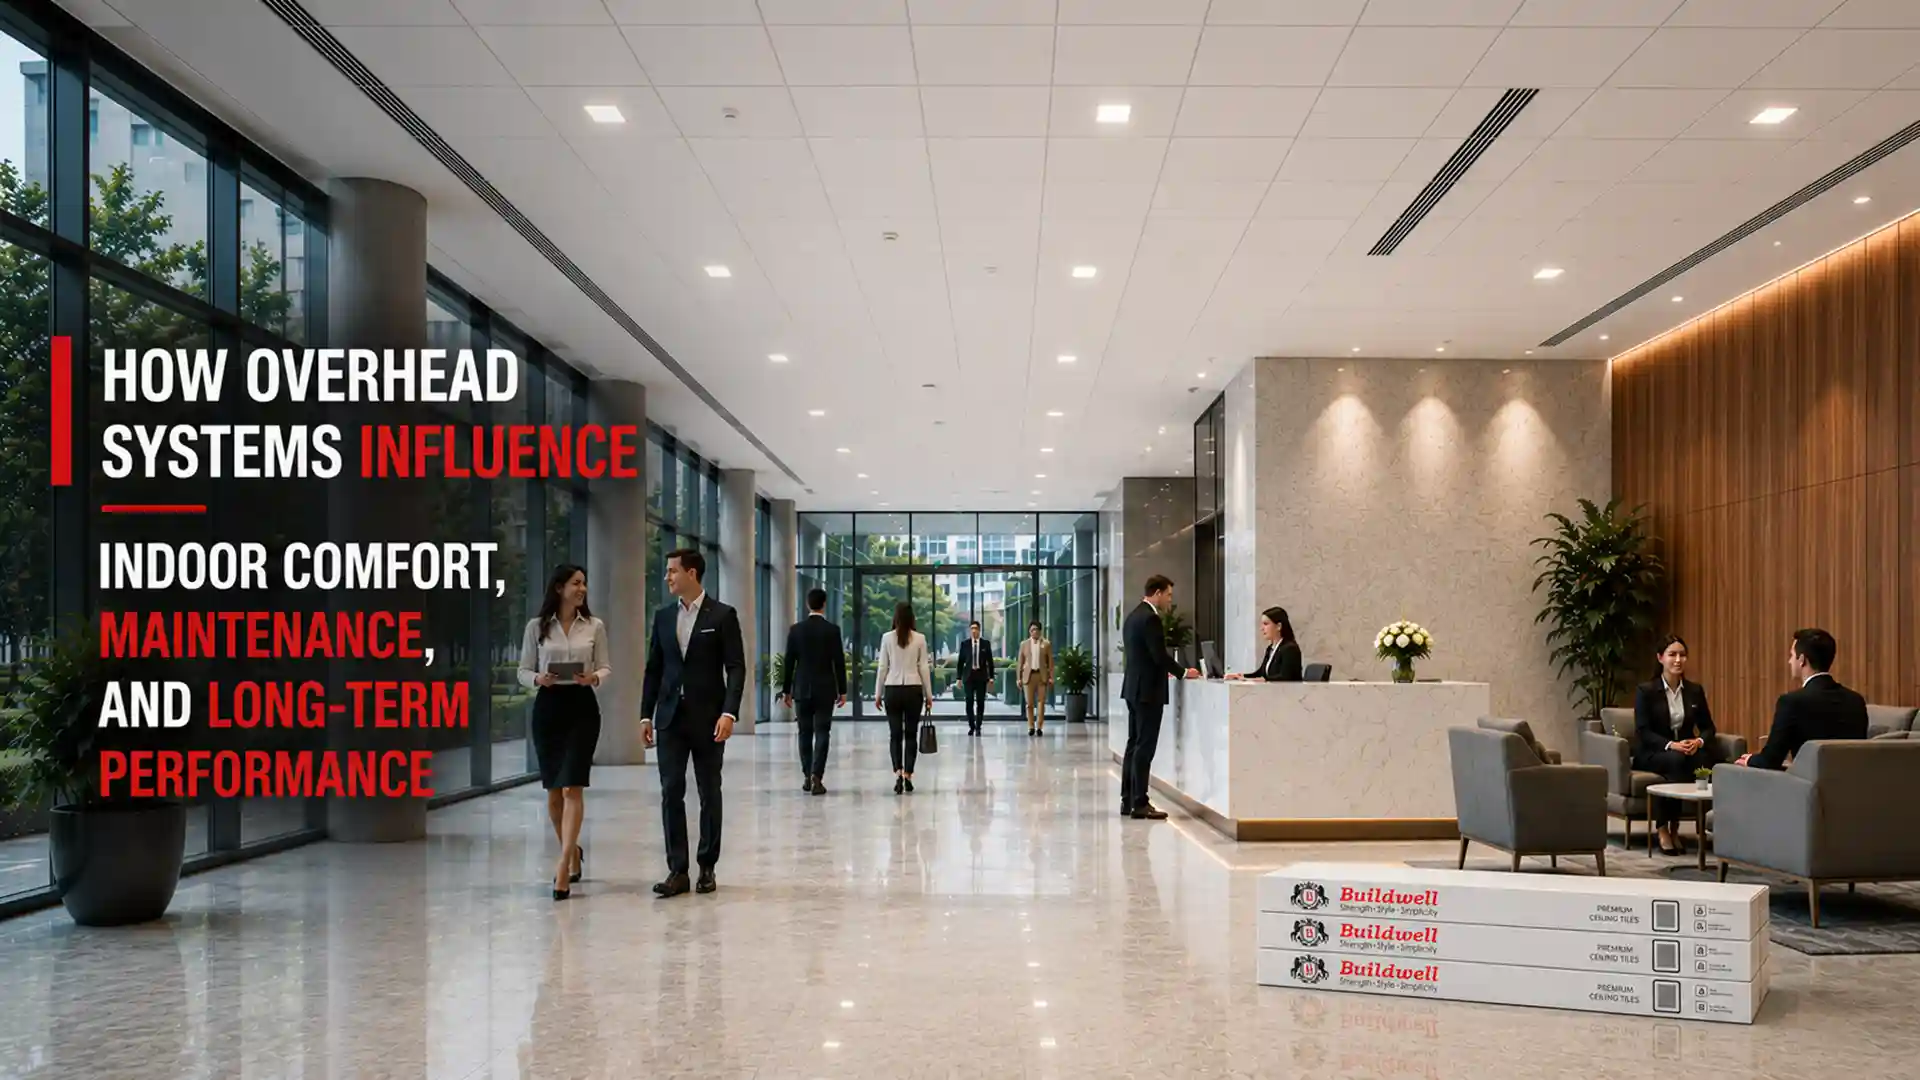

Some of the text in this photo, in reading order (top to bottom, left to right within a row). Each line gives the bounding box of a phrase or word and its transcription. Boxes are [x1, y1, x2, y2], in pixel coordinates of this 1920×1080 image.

[1339, 887, 1439, 906] Buildwell
[1597, 905, 1633, 914] PREMIUM
[1620, 915, 1640, 924] TILES
[1339, 923, 1438, 943] Buildwell
[1597, 944, 1634, 953] PREMIUM
[1620, 955, 1640, 964] TILES
[1339, 960, 1439, 982] Buildwell
[1597, 984, 1634, 993] PREMIUM
[1620, 995, 1640, 1004] TILES
